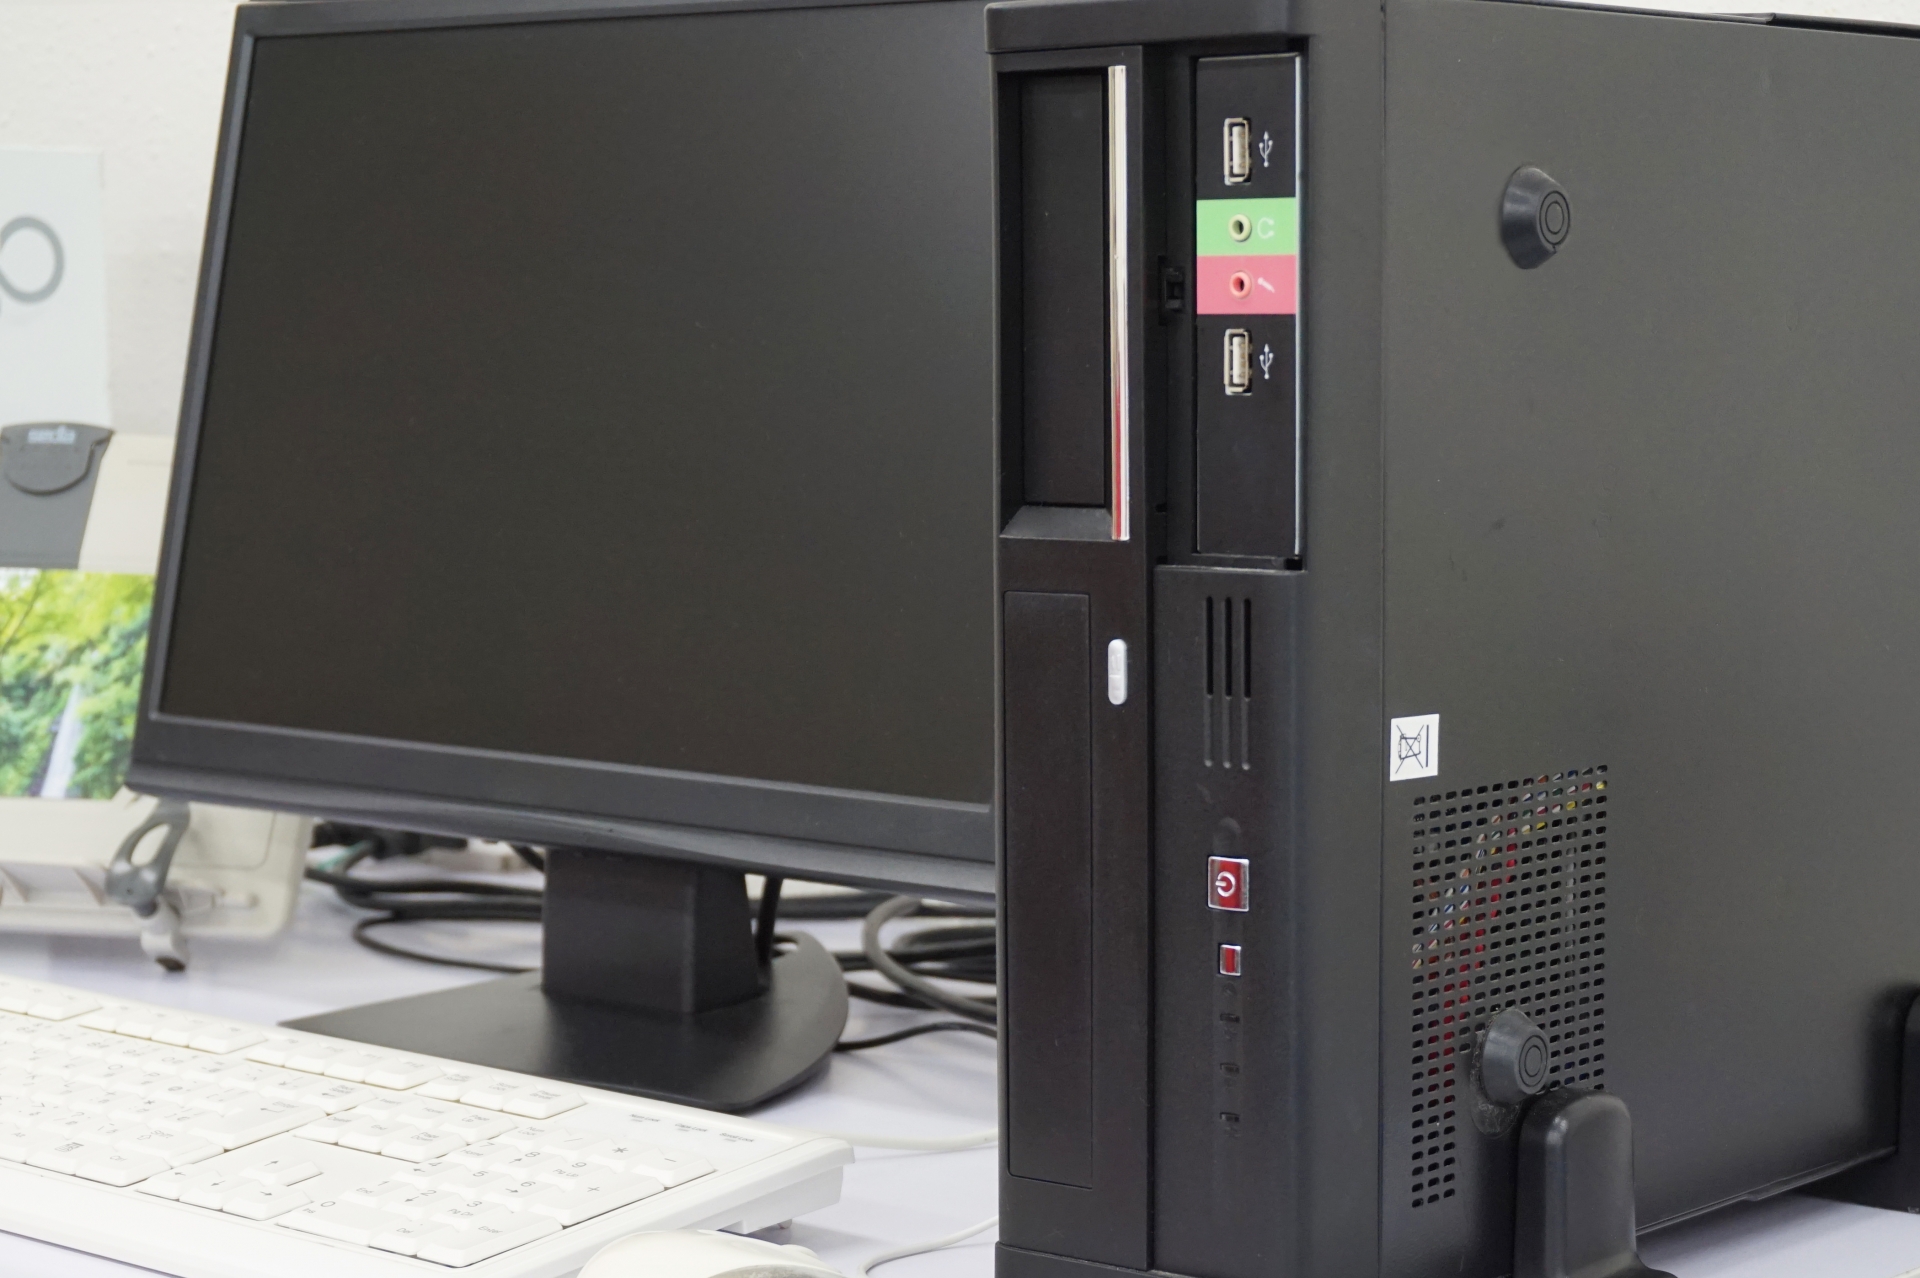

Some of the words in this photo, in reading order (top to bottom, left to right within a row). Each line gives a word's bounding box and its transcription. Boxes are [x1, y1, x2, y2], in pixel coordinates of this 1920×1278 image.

[410, 1134, 433, 1142] Down
[420, 1131, 440, 1139] Page
[473, 1170, 489, 1178] 5
[420, 1189, 437, 1197] 2
[466, 1200, 483, 1208] 3
[478, 1225, 503, 1234] Enter
